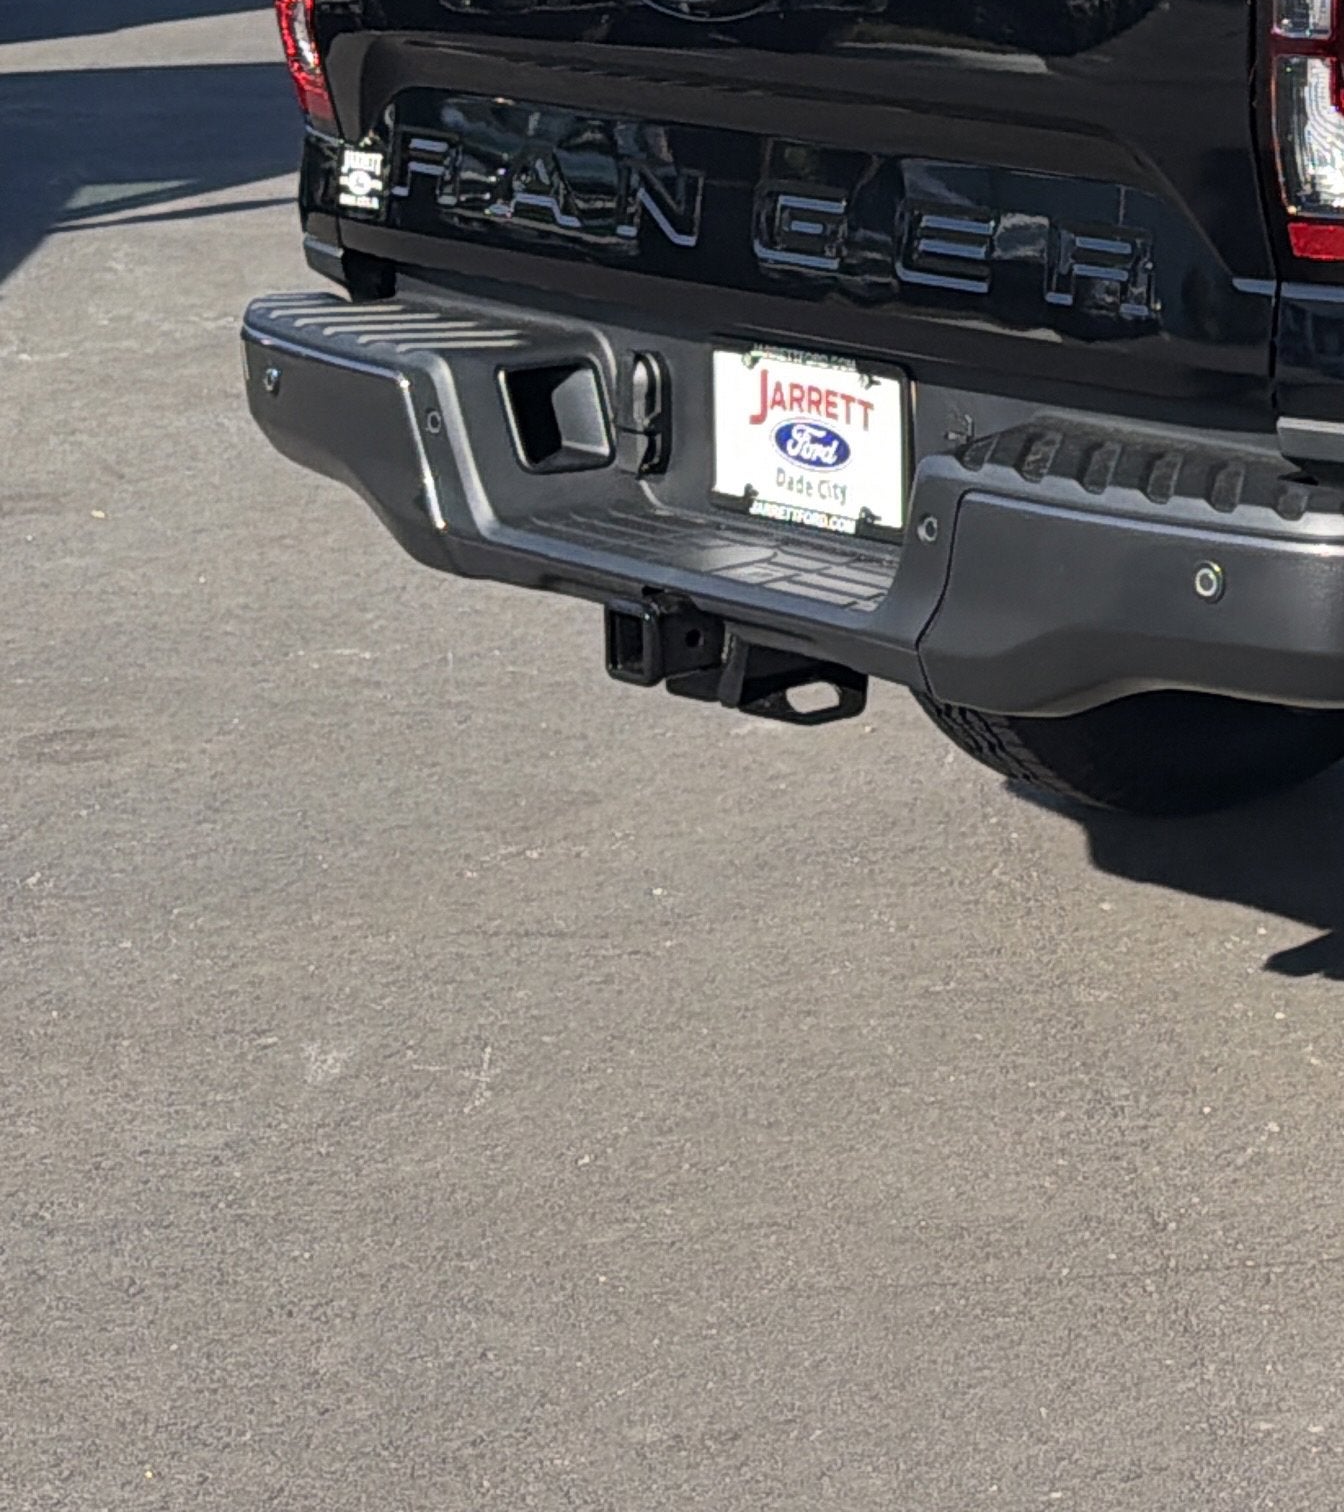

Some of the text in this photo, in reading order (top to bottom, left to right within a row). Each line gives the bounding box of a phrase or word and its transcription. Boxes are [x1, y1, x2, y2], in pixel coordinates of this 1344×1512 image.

[392, 128, 1161, 320] RANGER
[749, 369, 875, 431] JARRETT
[786, 424, 840, 465] Ford
[775, 466, 848, 506] Dade City
